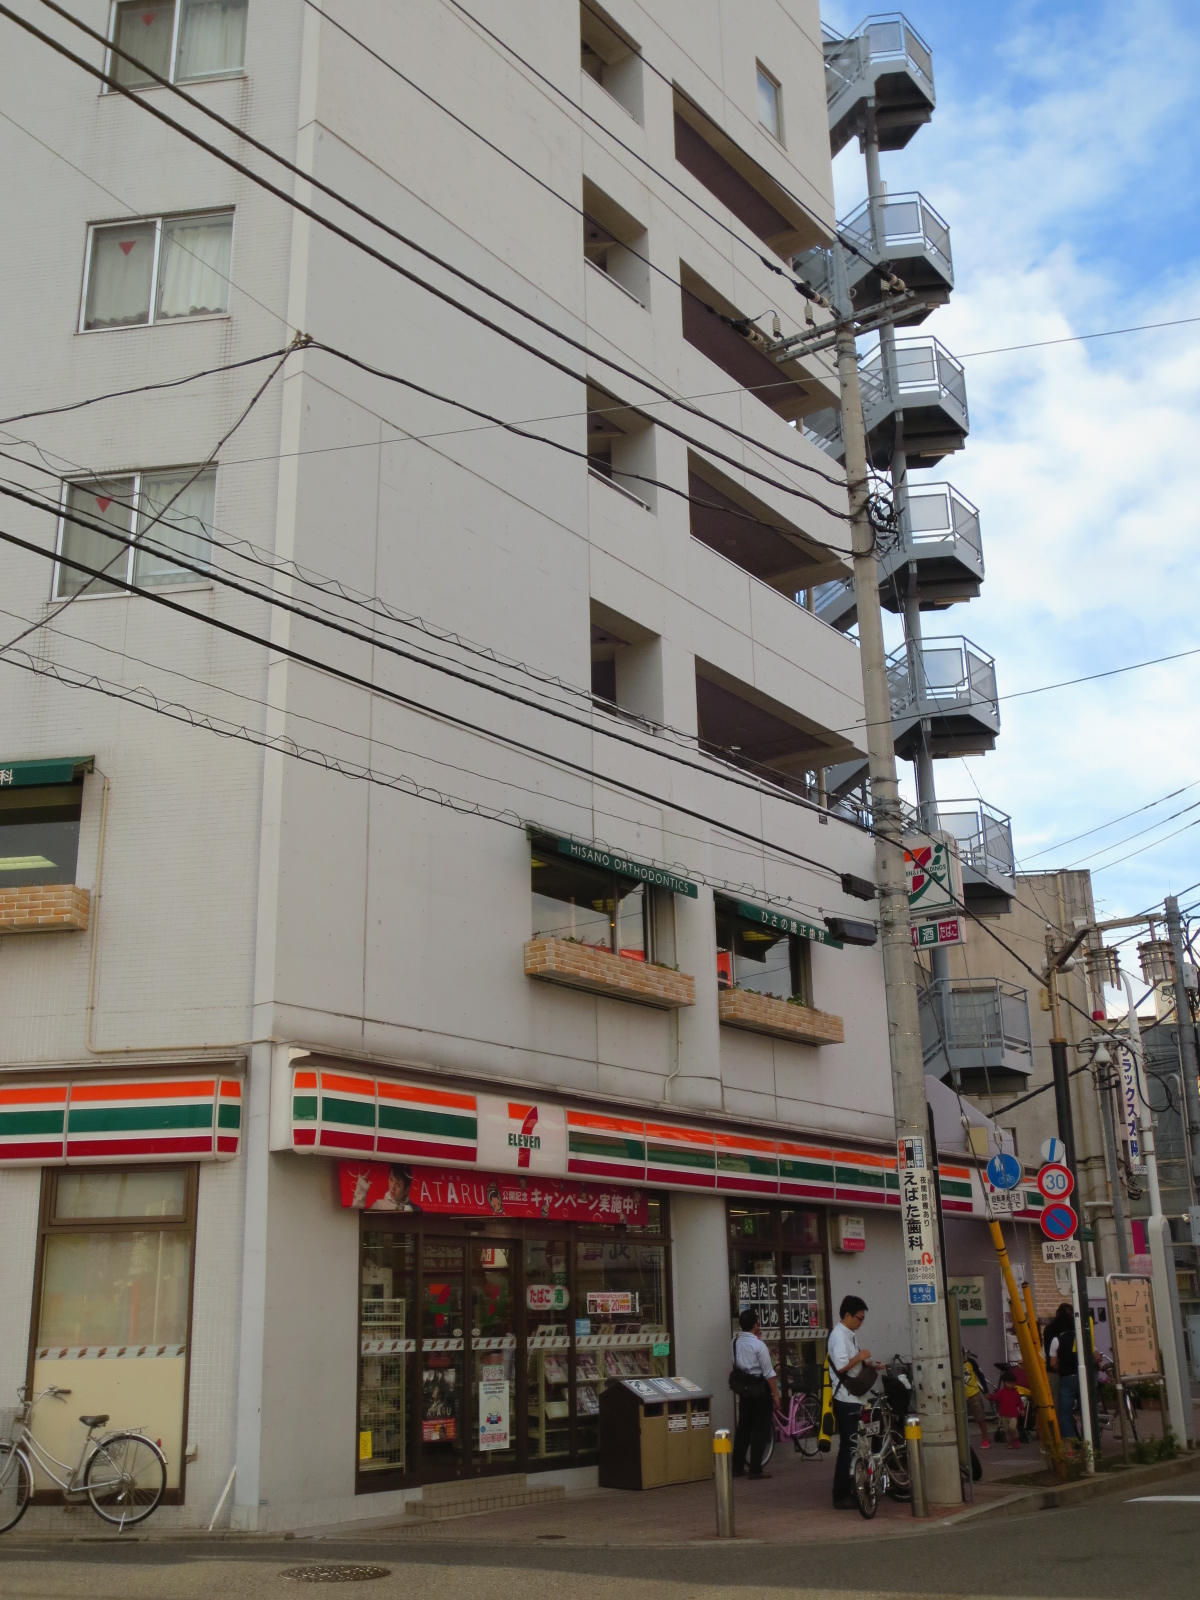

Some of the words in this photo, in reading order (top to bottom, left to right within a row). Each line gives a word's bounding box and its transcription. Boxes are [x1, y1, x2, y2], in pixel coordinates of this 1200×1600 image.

[570, 844, 610, 866] HISANO
[614, 859, 689, 893] ORTHODONTICS
[761, 911, 825, 944] ひさの矯正歯科
[922, 927, 935, 943] 酒
[939, 924, 958, 940] たばこ
[508, 1133, 541, 1150] ELEVEN
[1045, 1173, 1067, 1191] 30
[420, 1180, 485, 1206] ATARU
[502, 1190, 529, 1202] 公開記念
[904, 1171, 923, 1251] えばた歯科
[992, 1201, 1022, 1210] ここまで
[529, 1288, 551, 1304] たばこ
[754, 1308, 809, 1325] じめました
